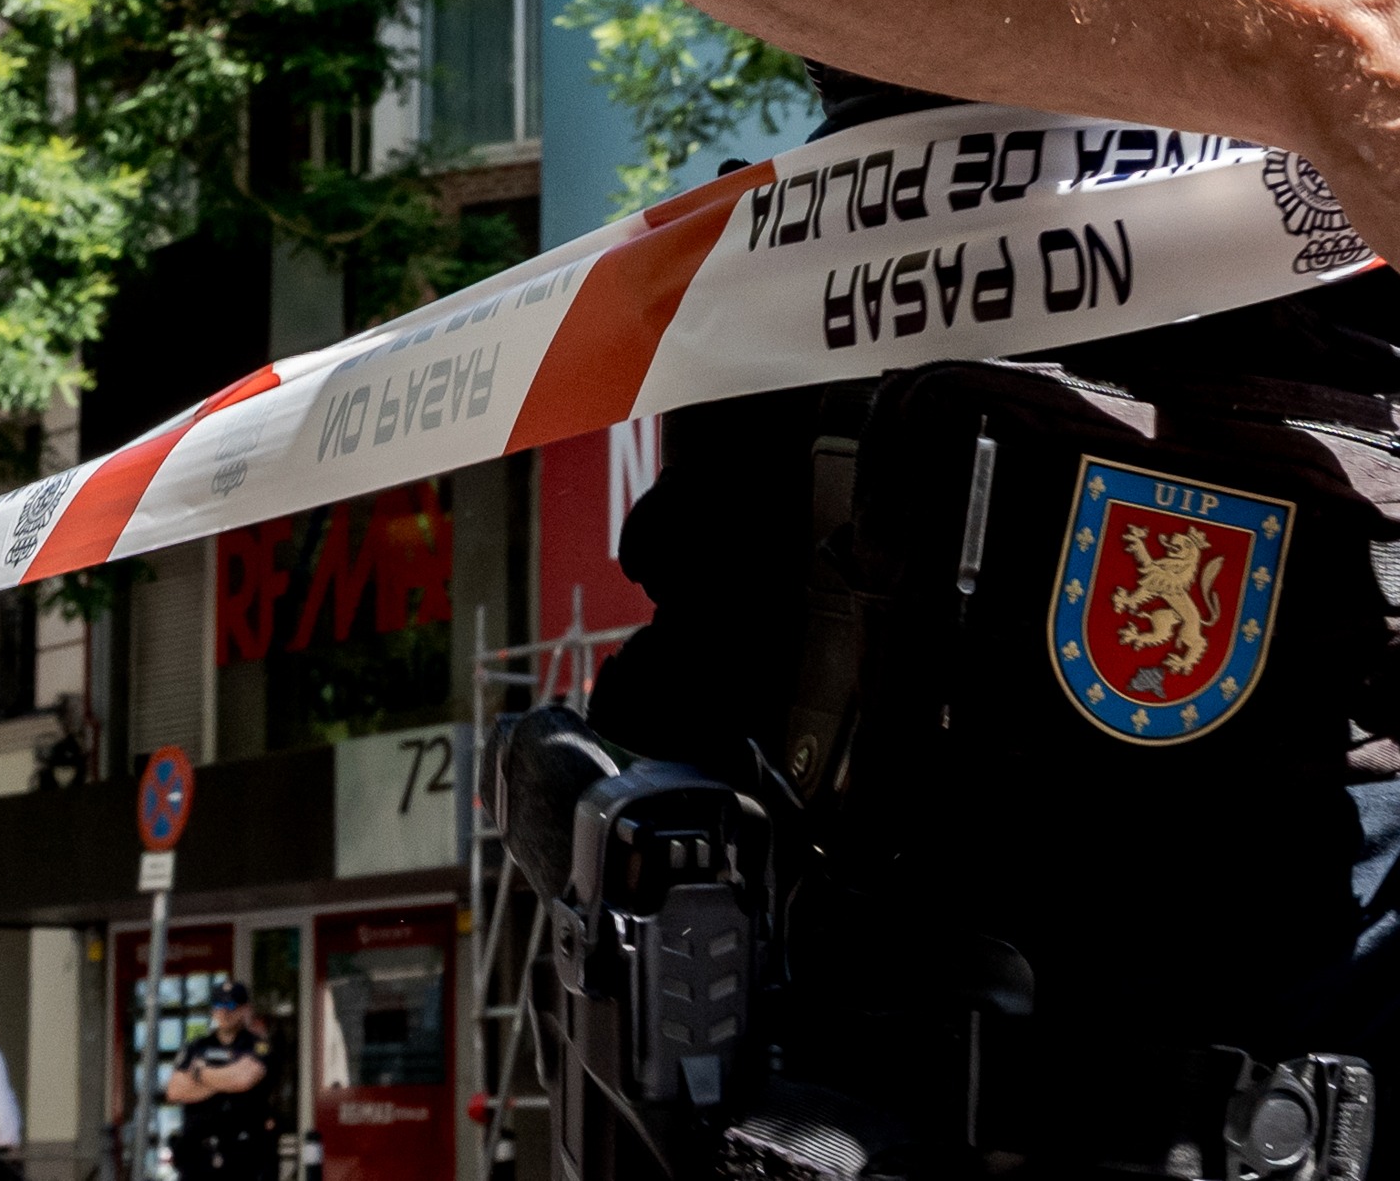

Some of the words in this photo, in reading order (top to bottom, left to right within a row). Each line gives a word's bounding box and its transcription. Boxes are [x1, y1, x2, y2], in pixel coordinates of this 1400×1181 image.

[948, 129, 1048, 212] DE
[823, 235, 1015, 351] PASAR
[1039, 219, 1133, 314] NO
[1153, 483, 1220, 516] UIP
[399, 736, 455, 815] 72
